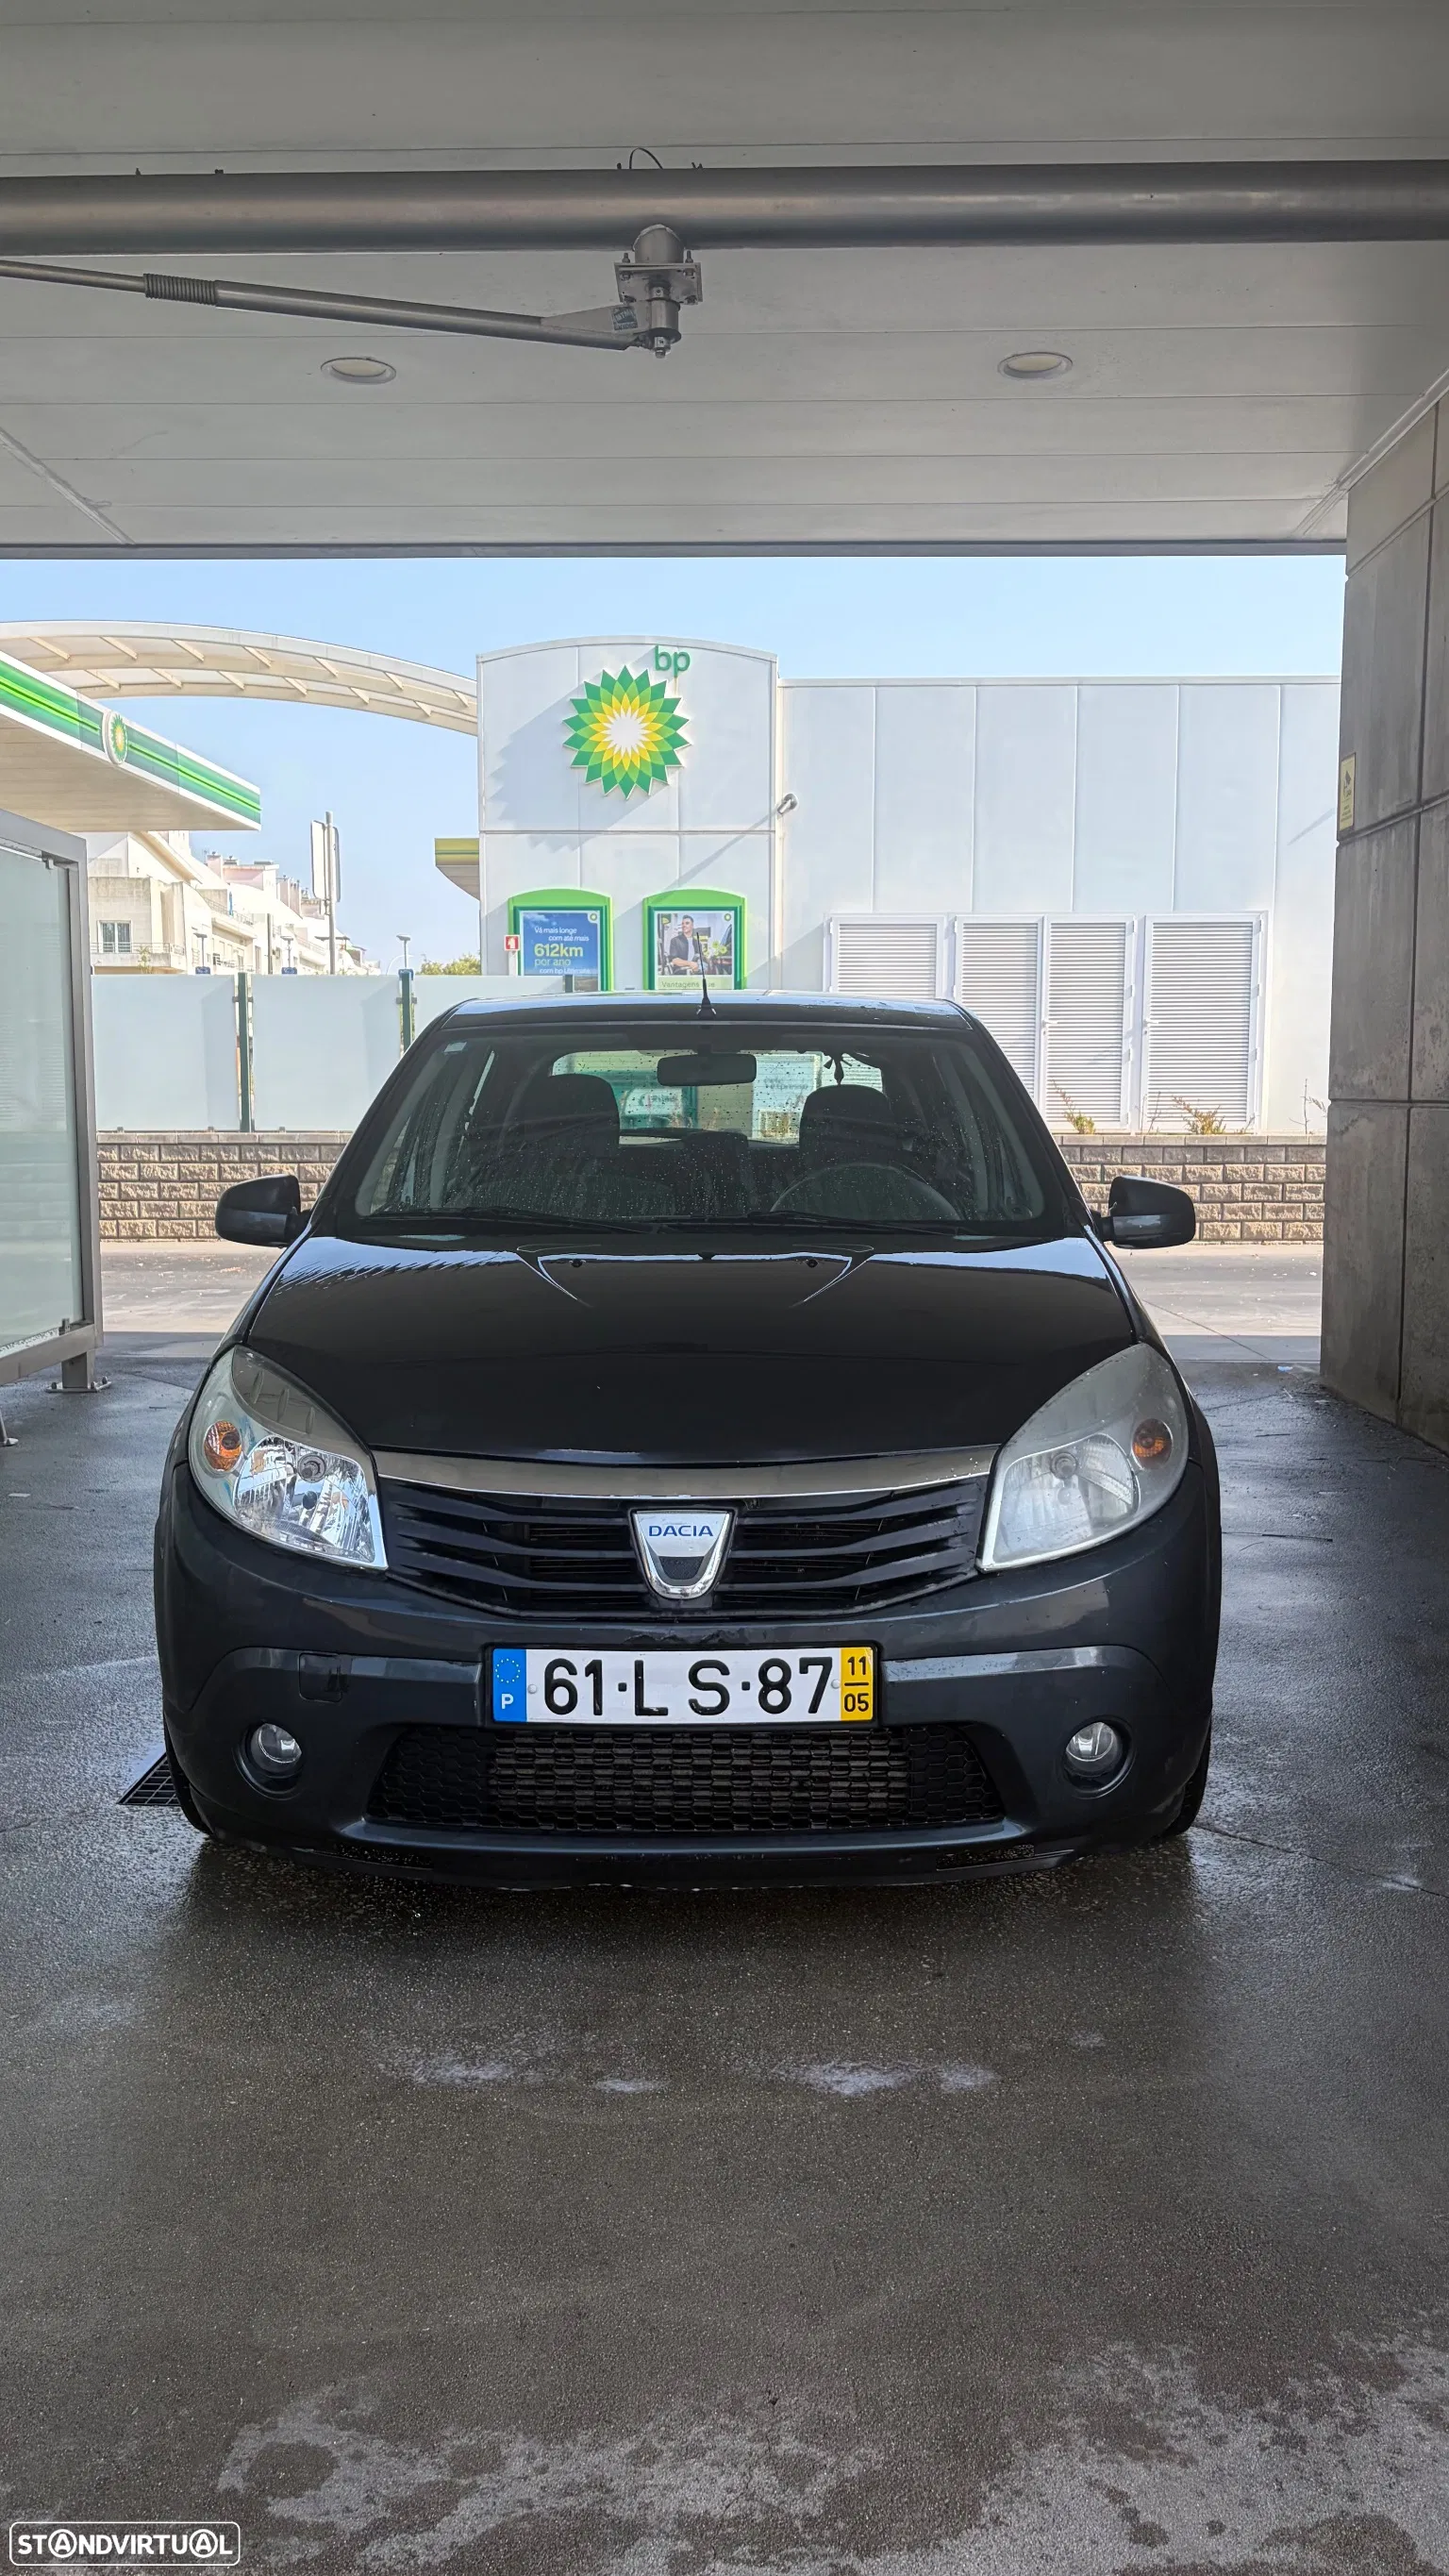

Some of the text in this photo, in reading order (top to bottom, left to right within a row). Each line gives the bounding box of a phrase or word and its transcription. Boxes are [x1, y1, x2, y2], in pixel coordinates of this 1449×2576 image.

[655, 644, 691, 677] bp
[559, 927, 577, 935] longe
[534, 944, 583, 957] 612km
[535, 958, 550, 967] por
[662, 981, 700, 989] Vantagens
[648, 1525, 714, 1537] DACIA
[847, 1656, 867, 1676] 11
[501, 1693, 514, 1710] P
[843, 1693, 869, 1713] 05
